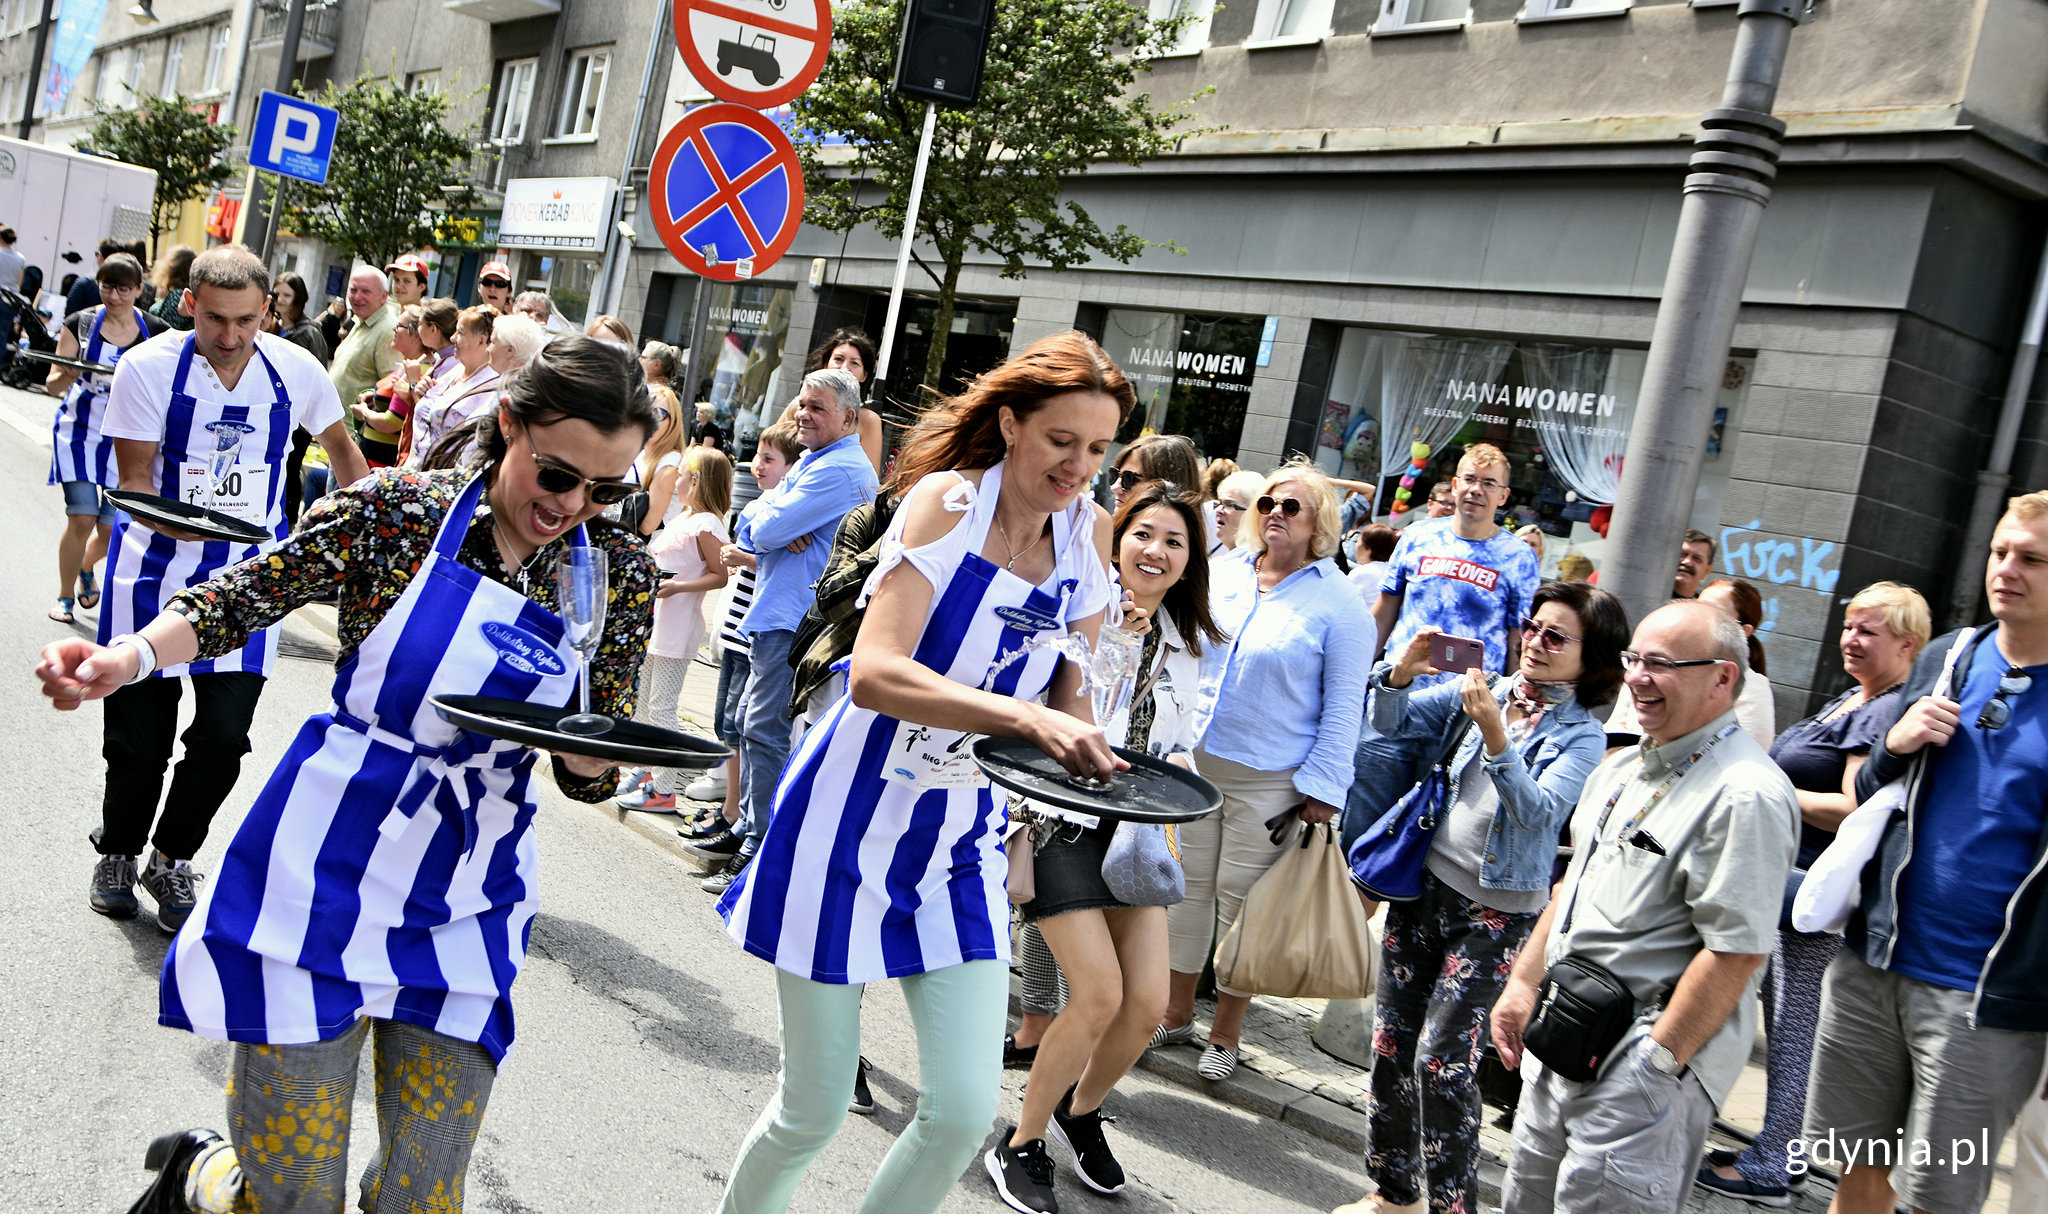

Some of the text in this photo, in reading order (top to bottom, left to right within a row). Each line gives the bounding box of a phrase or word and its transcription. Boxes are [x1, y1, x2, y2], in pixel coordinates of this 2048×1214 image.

[268, 102, 320, 164] P
[1423, 407, 1463, 419] BIELIZNA
[1471, 412, 1509, 425] TOREBKI
[1516, 417, 1566, 432] BIŻUTERIA
[532, 648, 561, 671] Rybne
[922, 752, 940, 765] BIEG
